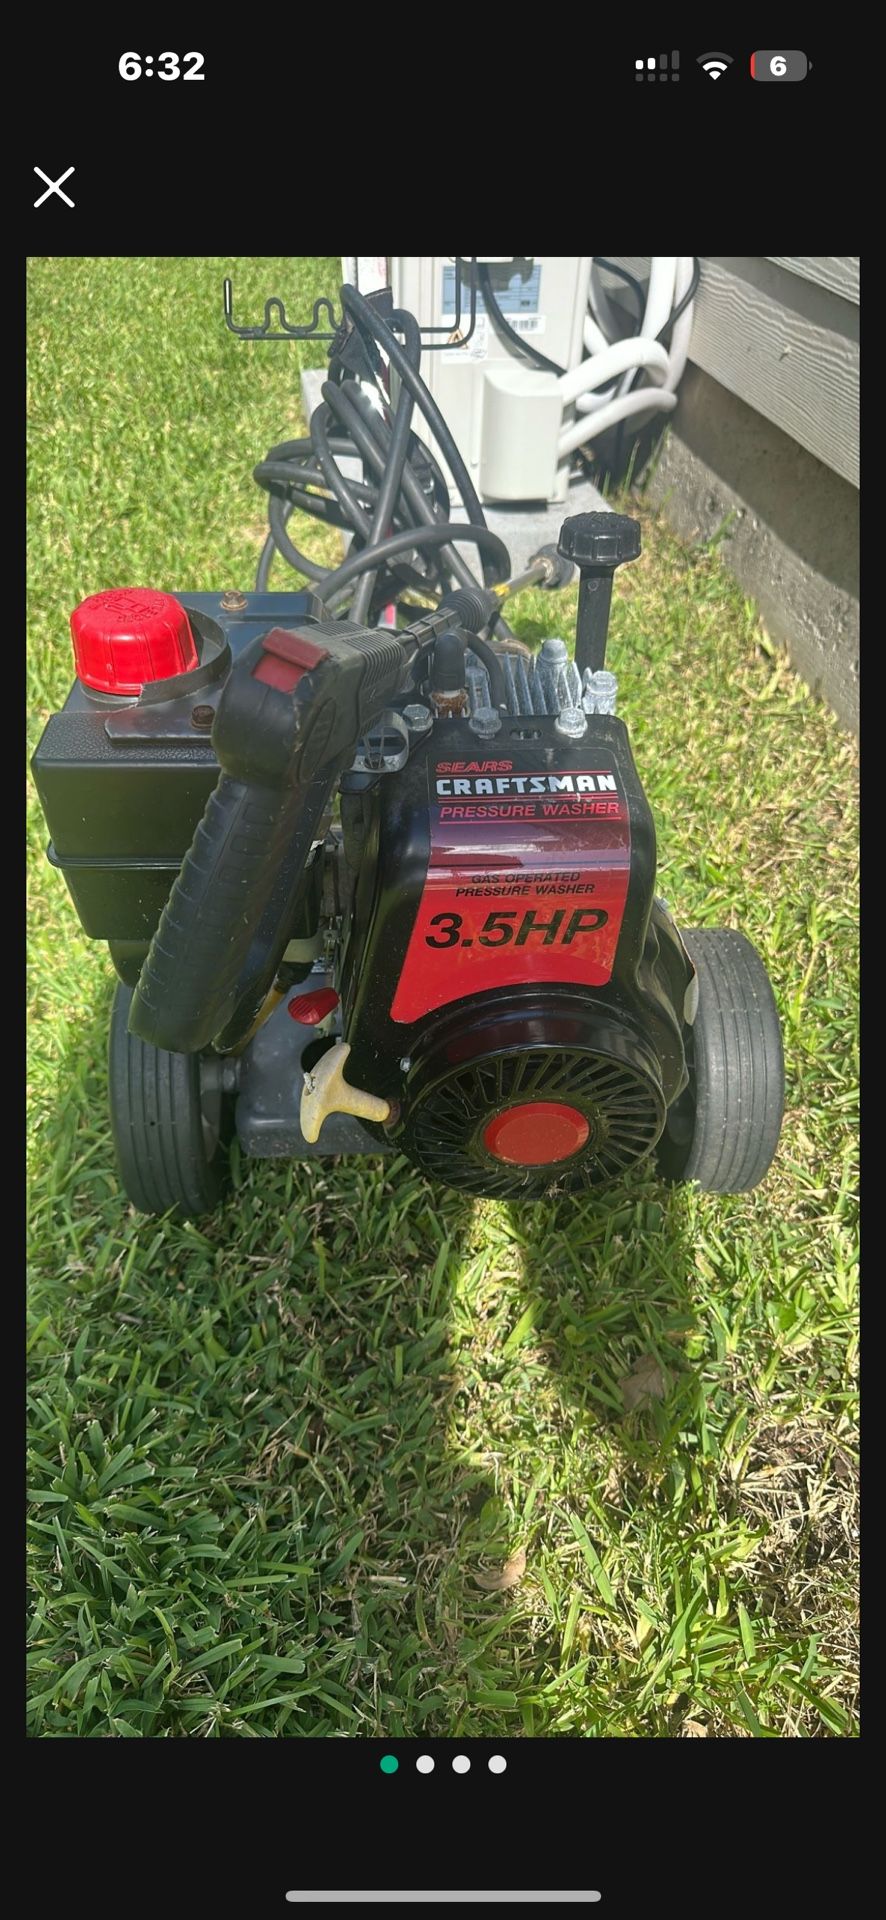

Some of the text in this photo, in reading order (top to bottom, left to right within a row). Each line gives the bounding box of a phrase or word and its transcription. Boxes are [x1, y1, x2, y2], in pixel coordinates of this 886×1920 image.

[435, 760, 513, 774] SEARS
[436, 774, 618, 796] CRAFTSMAN
[440, 802, 619, 818] PRESSURE WASHER
[471, 871, 581, 885] GAS OPERATED
[456, 883, 596, 897] PRESSURE WASHER
[425, 908, 609, 949] 3.5HP
